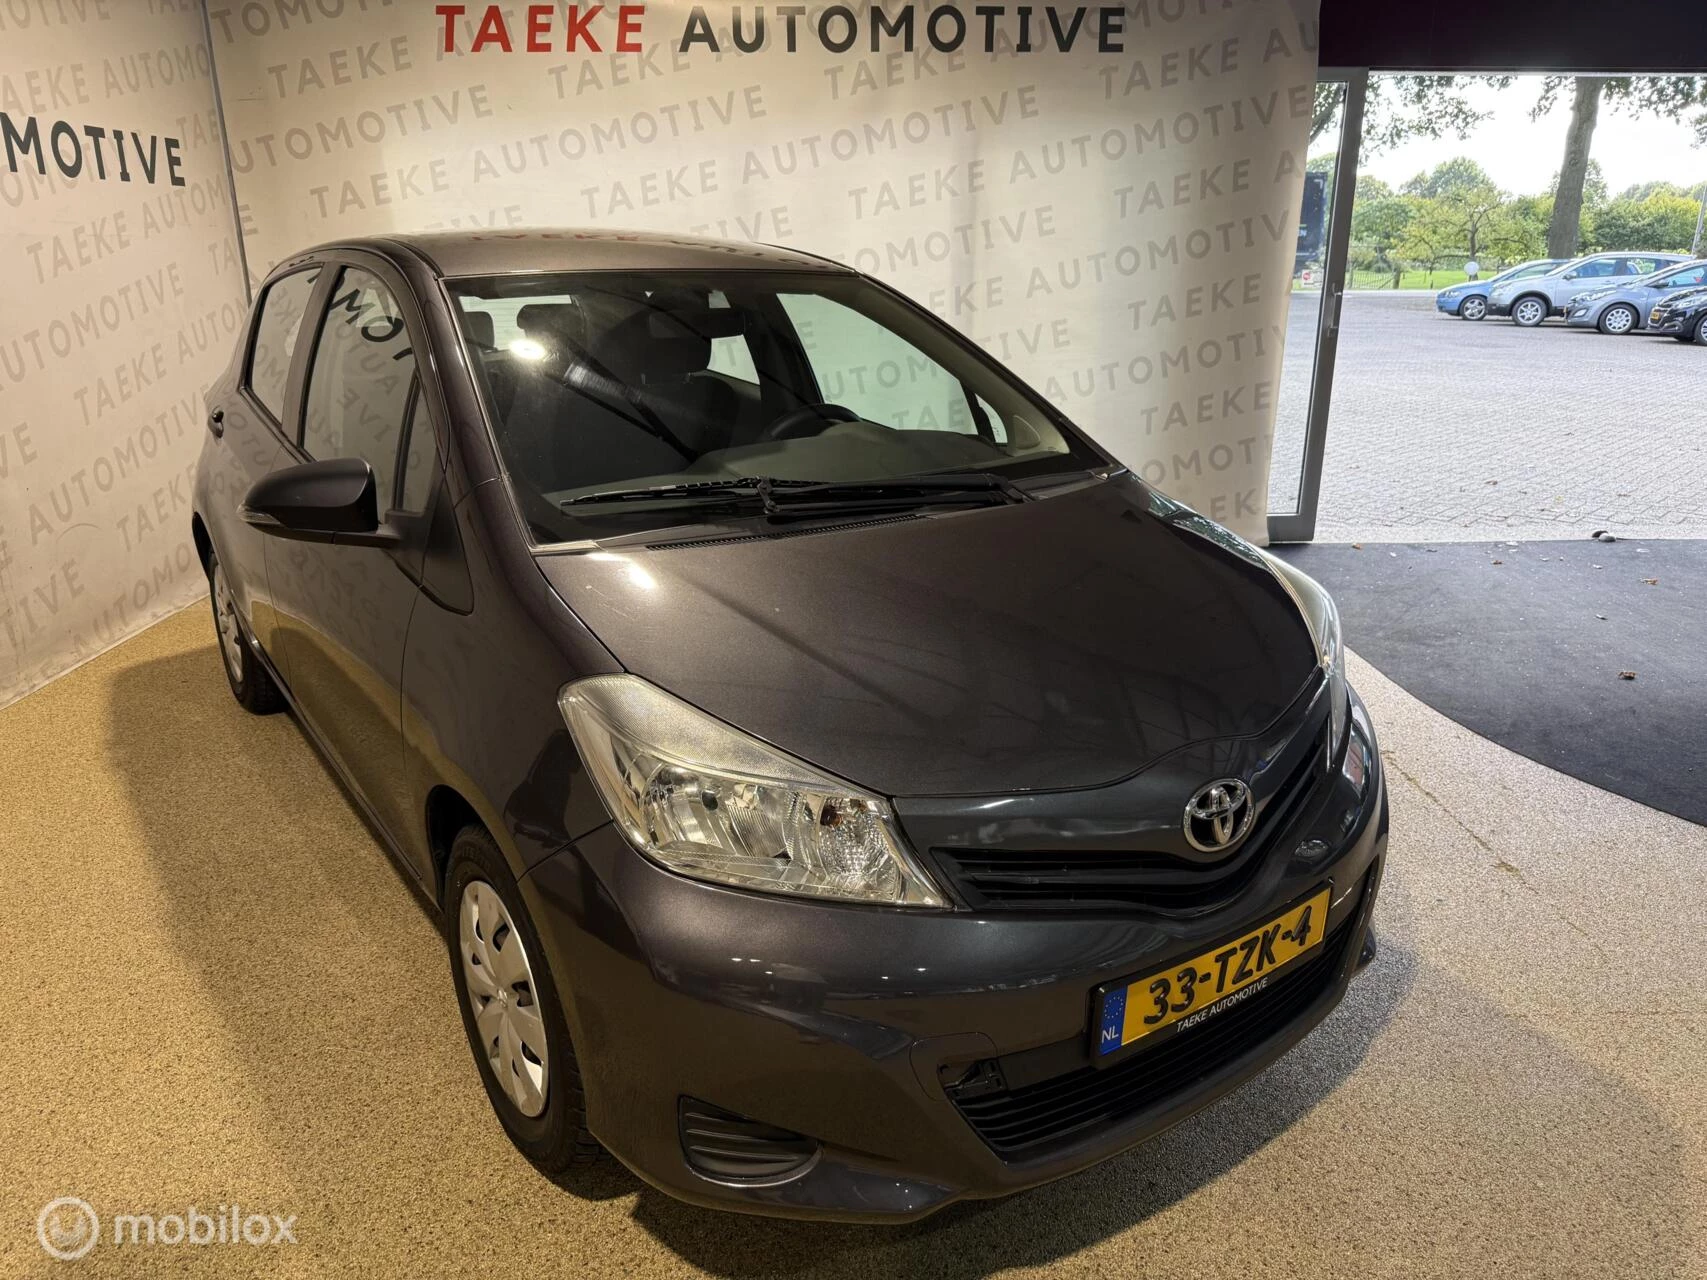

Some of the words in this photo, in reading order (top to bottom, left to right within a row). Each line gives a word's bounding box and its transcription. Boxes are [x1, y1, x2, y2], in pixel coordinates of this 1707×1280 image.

[436, 5, 645, 52] TAEKE
[679, 4, 1124, 52] AUTOMOTIVE
[268, 36, 412, 98] TAEKE
[548, 37, 691, 100] TAEKE
[0, 111, 186, 187] MOTIVE
[310, 159, 450, 219] TAEKE
[474, 84, 767, 184] AUTOMOTIVE
[824, 46, 966, 101] TAEKE
[580, 160, 718, 219] TAEKE
[742, 84, 1039, 185] AUTOMOTIVE
[1099, 37, 1240, 100] TAEKE
[849, 159, 985, 220] TAEKE
[1010, 84, 1309, 184] AUTOMOTIVE
[1114, 158, 1251, 219] TAEKE
[26, 210, 131, 284] TAEKE
[1026, 210, 1289, 299] AUTOMOTIV
[0, 262, 184, 392] UTOMOTIVE
[1128, 273, 1261, 331] TAEKE
[74, 343, 167, 426] TAEKE
[1141, 380, 1271, 435] TAEKE
[1143, 905, 1312, 1025] 33-TZK-4
[1101, 1027, 1119, 1043] NL
[1176, 1011, 1208, 1033] TAEKE
[1209, 977, 1268, 1015] AUTOMOTIVE
